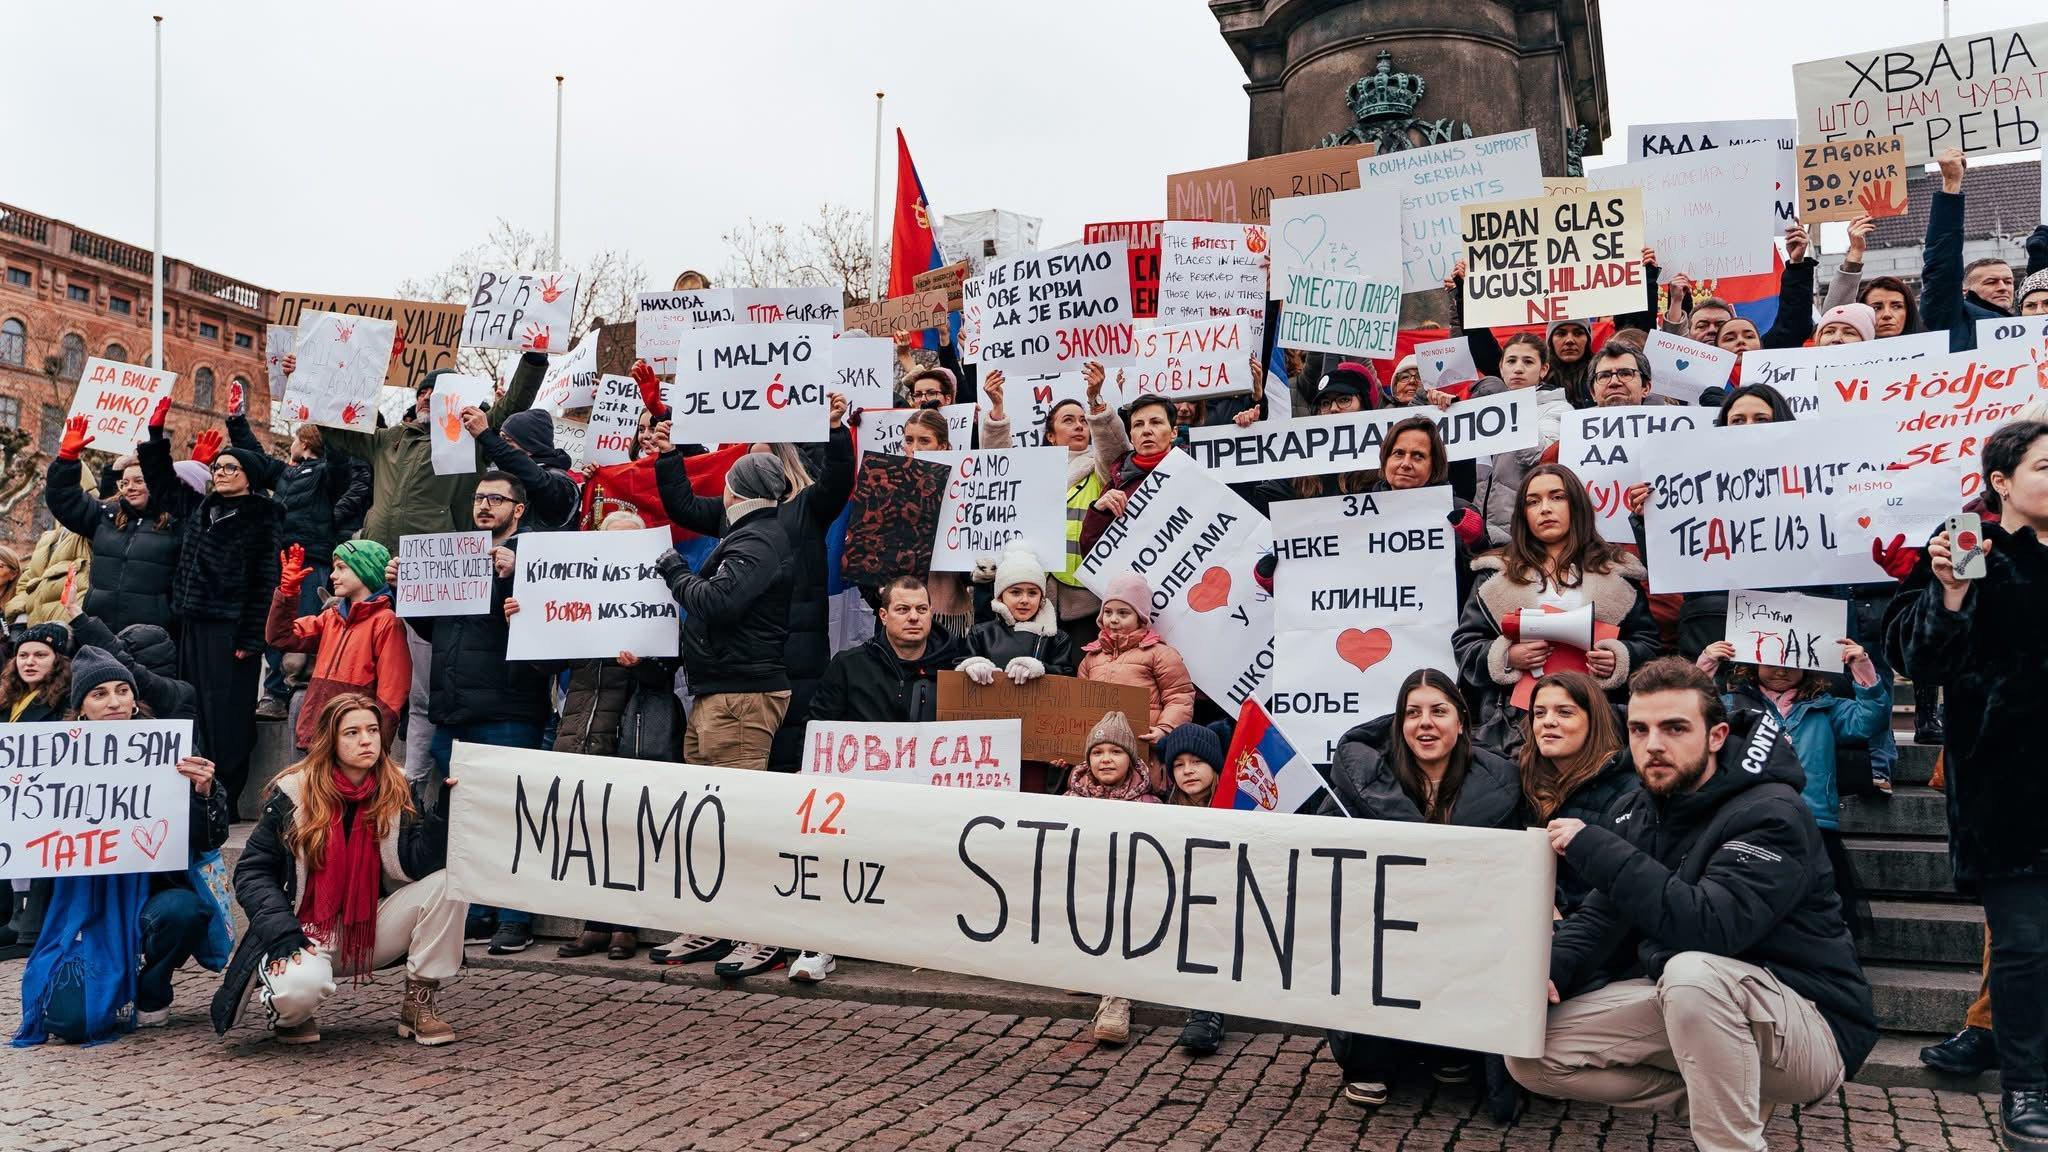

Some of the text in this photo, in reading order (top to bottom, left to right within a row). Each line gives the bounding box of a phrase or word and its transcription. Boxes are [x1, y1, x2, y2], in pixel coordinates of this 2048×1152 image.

[1845, 32, 2037, 99] ХВАЛА
[1818, 99, 1870, 132] ШТО
[1887, 88, 1941, 122] НАМ
[1475, 134, 1531, 157] SUPPORT
[1642, 134, 1719, 158] КАДА
[1803, 139, 1900, 168] ZAGORKA
[1413, 161, 1484, 185] SERBIAN
[1805, 164, 1898, 192] DO YOUR
[1403, 179, 1505, 210] STUDENTS
[1806, 190, 1853, 212] JOB!
[1462, 207, 1539, 242] JEDAN
[1555, 198, 1625, 232] GLAS
[1192, 236, 1236, 250] HOTTEST
[1469, 231, 1625, 272] MOŽE DA SE
[988, 250, 1112, 288] НЕ БИ БИЛО
[1175, 254, 1257, 265] PLACES IN HELL
[1166, 272, 1259, 283] ARE RESERVED FOR
[641, 295, 704, 311] ЊИХОВА
[987, 285, 1021, 309] ОВЕ
[1029, 279, 1082, 302] КРВИ
[1165, 290, 1190, 299] THOSE
[1224, 290, 1234, 299] IN
[1237, 291, 1264, 299] TIMES
[1286, 273, 1400, 315] УМЕСТО ПАРА
[747, 303, 839, 324] TITTA EUROPA
[852, 301, 889, 323] ЗБОГ
[901, 291, 933, 314] ВАС
[911, 311, 929, 328] ОД
[993, 296, 1119, 329] ДА ЈЕ БИЛО
[1164, 306, 1176, 315] OF
[1210, 306, 1231, 317] MORAL
[1527, 296, 1569, 323] NE
[403, 308, 464, 348] УЛИЦИ
[469, 309, 524, 344] ПАР
[1280, 311, 1397, 352] ПЕРИТЕ ОБРАЗЕ!
[1995, 325, 2026, 340] OD
[697, 349, 703, 371] I
[714, 335, 812, 369] MALMÖ
[982, 340, 1015, 361] СВЕ
[1021, 335, 1050, 356] ПО
[1055, 322, 1133, 361] ЗАКОНУ
[1657, 339, 1719, 363] MOJ NOVI SAD
[1168, 357, 1181, 368] PA
[89, 366, 162, 393] ДА ВИШЕ
[1139, 362, 1230, 395] ROBIJA
[1835, 378, 1868, 402] Vi
[96, 391, 149, 416] НИКО
[682, 373, 824, 415] JE UZ ĆACI
[1033, 385, 1053, 404] И
[97, 416, 128, 435] ОДЕ
[592, 413, 611, 423] OCH
[1190, 402, 1519, 469] ПРЕКАРДАИЛО!
[960, 454, 1010, 479] САМО
[1580, 445, 1629, 466] ДА
[949, 480, 1023, 501] СТУДЕНТ
[1655, 470, 1712, 510] ЗБОГ
[1848, 482, 1893, 494] MI SMO
[956, 502, 1017, 525] СРБИНА
[1342, 494, 1380, 517] ЗА
[1887, 497, 1904, 507] UZ
[1083, 470, 1171, 575] ПОДРШКА
[401, 536, 485, 557] ЛУТКЕ ОД КРВИ
[1273, 535, 1340, 560] НЕКЕ
[1368, 528, 1445, 554] НОВЕ
[1670, 516, 1767, 563] ТЕДКЕ
[1775, 515, 1809, 551] ИЗ
[400, 557, 492, 581] БЕЗ ТРУНКЕ ИДЕЈЕ
[602, 562, 632, 582] NAS
[399, 581, 488, 603] УБИЦЕ НА ЦЕСТИ
[1311, 585, 1424, 612] КЛИНЦЕ,
[545, 600, 593, 623] BORBA
[598, 602, 629, 621] NAS
[1231, 604, 1250, 627] У
[1274, 692, 1360, 714] БОЉЕ
[124, 730, 182, 768] SAM
[813, 731, 918, 774] НОВИ
[929, 735, 999, 768] САД
[796, 788, 848, 835] 1.2.
[25, 828, 121, 872] TATE
[510, 782, 1428, 1010] MALMÖ JE UZ STUDENTE
